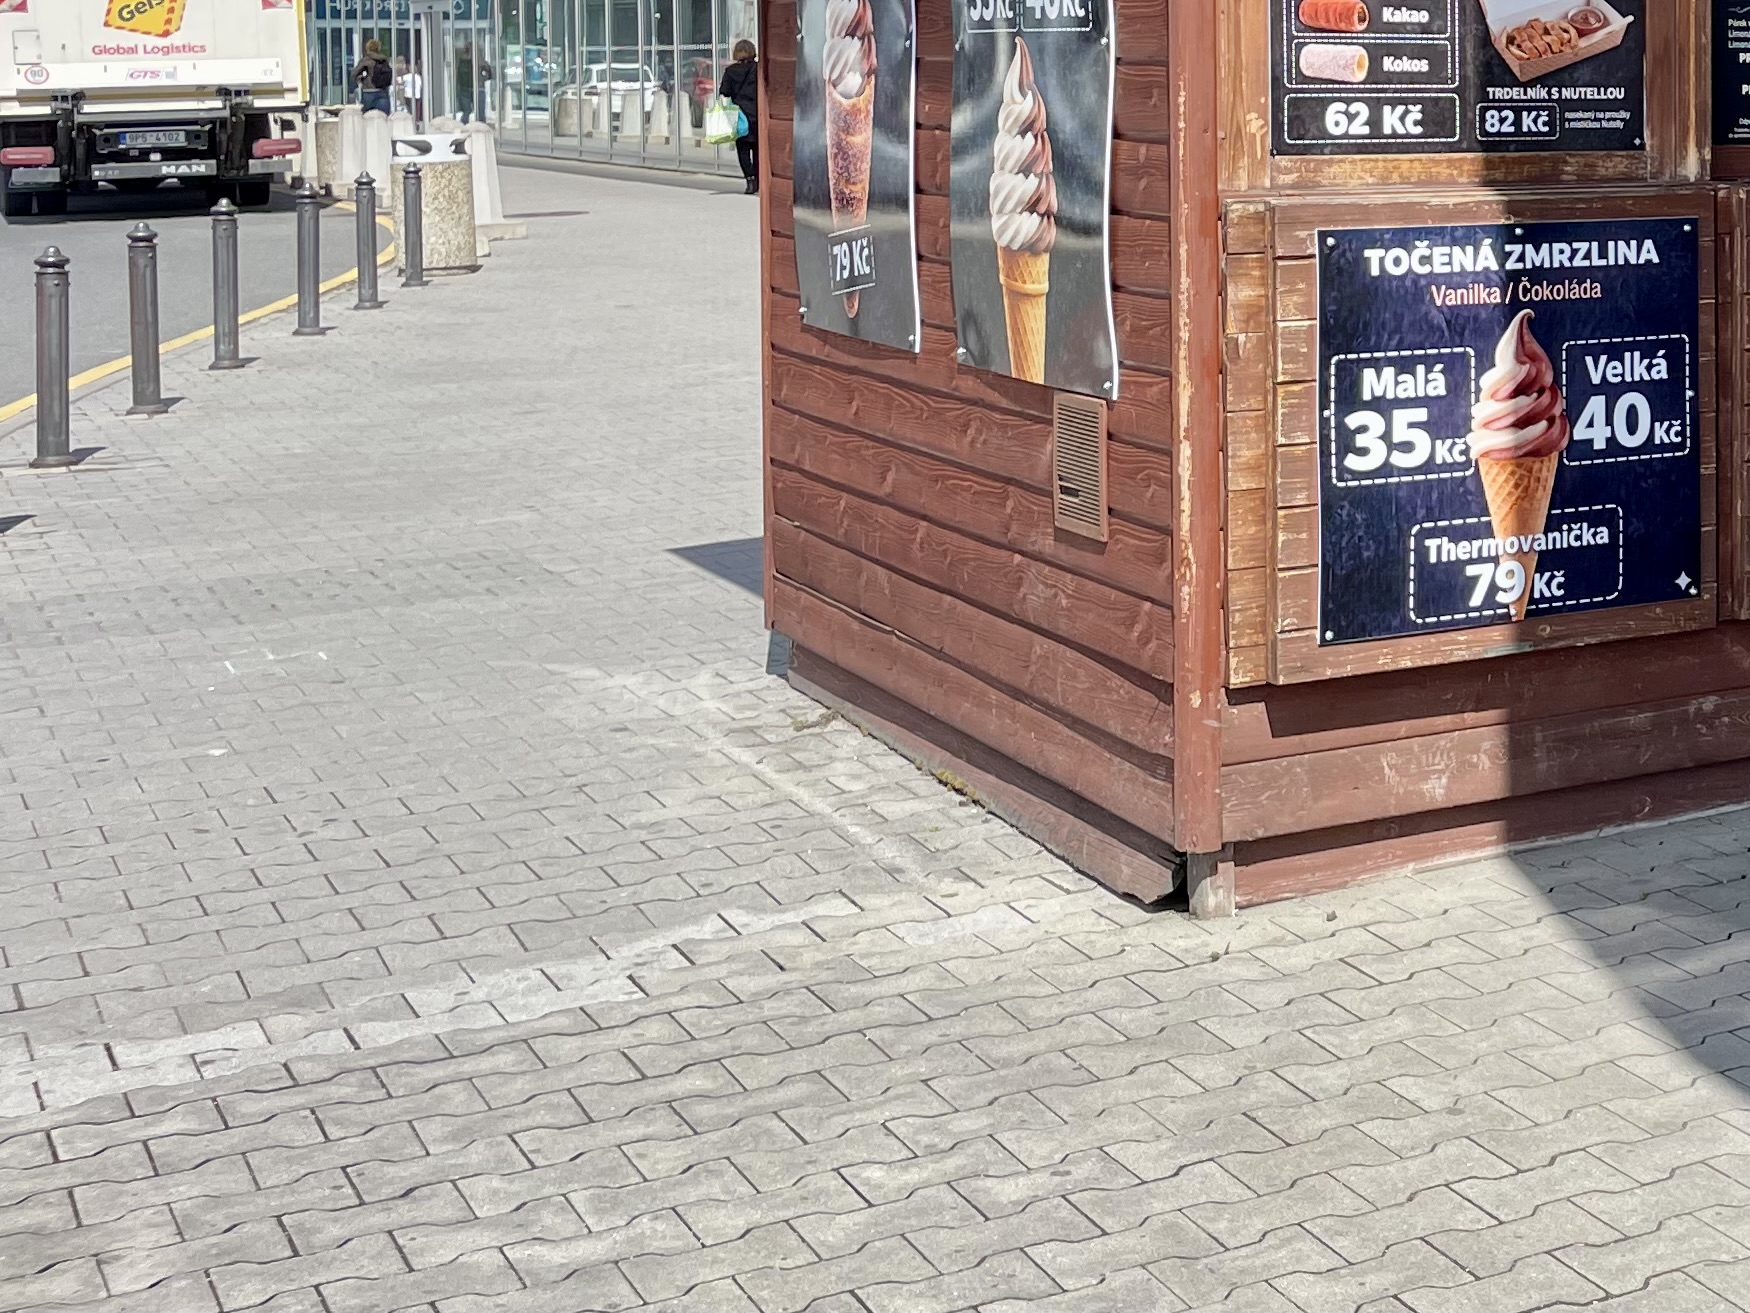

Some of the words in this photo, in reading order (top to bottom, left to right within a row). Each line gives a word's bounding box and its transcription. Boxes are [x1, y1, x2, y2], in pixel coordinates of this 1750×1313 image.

[1382, 7, 1429, 23] Kakao
[91, 43, 139, 56] Global
[143, 42, 207, 56] Logistics
[1383, 56, 1429, 72] Kokos
[128, 70, 162, 80] GTS
[1487, 84, 1548, 99] TRDELNÍK
[1551, 87, 1559, 99] S
[1562, 87, 1624, 99] NUTELLOU
[1325, 102, 1369, 135] 62
[1383, 105, 1423, 134] Kč
[1485, 110, 1515, 132] 82
[1522, 111, 1549, 132] Kč
[161, 164, 206, 174] MAN
[832, 240, 851, 282] 79
[853, 235, 871, 278] Kč
[1363, 238, 1499, 277] TOČENÁ
[1504, 238, 1660, 271] ZMRZLINA
[1430, 284, 1501, 307] Vanilka
[1518, 278, 1602, 302] Čokoláda
[1363, 364, 1446, 400] Malá
[1585, 350, 1668, 384] Velká
[1573, 392, 1651, 449] 40
[1654, 420, 1681, 444] Kč
[1342, 406, 1432, 473] 35
[1434, 434, 1467, 464] Kč
[1424, 521, 1610, 564] Thermovanička
[1465, 559, 1526, 608] 79
[1534, 570, 1566, 598] Kč
